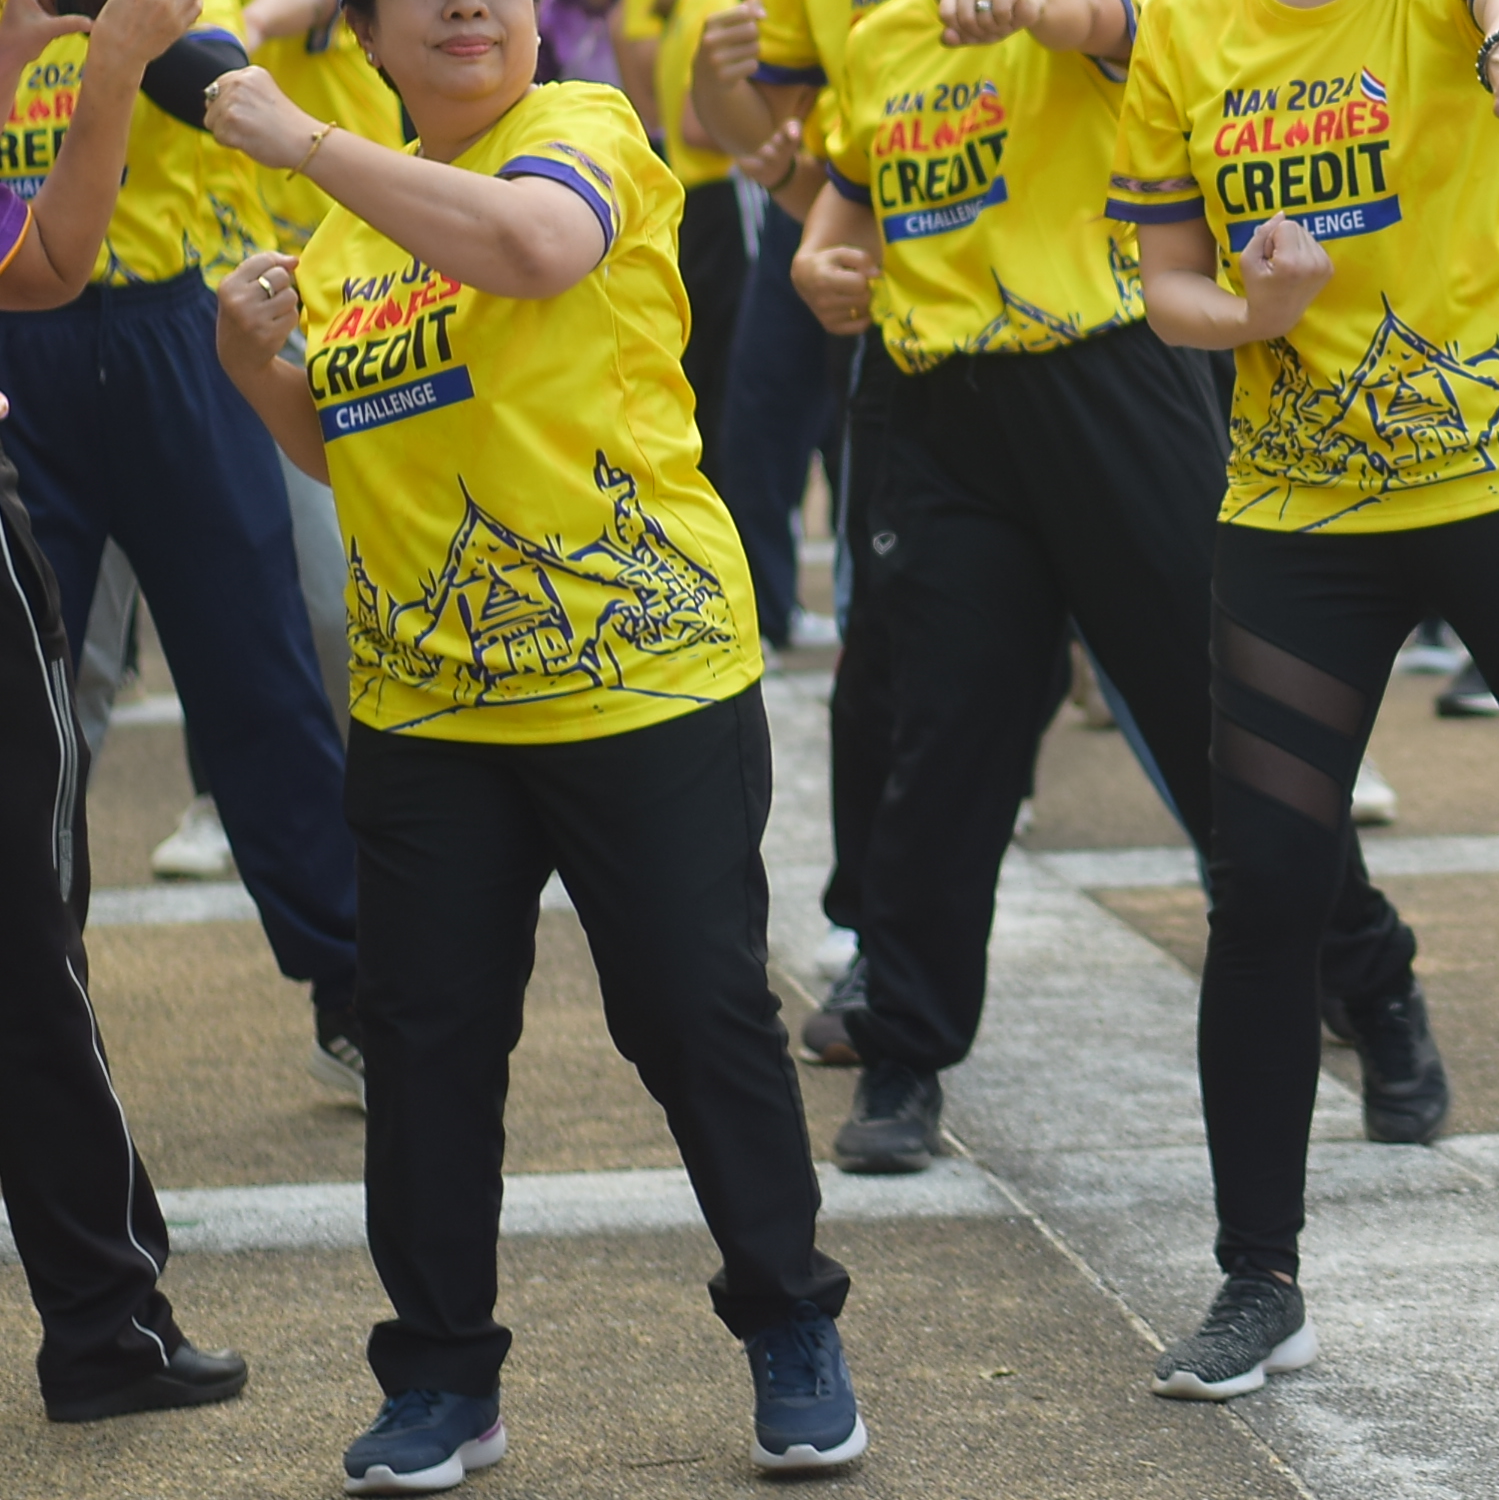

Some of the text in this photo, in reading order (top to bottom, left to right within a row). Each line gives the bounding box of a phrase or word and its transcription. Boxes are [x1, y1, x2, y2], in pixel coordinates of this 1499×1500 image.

[1222, 72, 1357, 118] NAN 2024
[878, 129, 1009, 209] CREDIT
[1216, 140, 1390, 215] CREDIT
[905, 200, 984, 234] CHALLEN
[343, 271, 396, 306] NAN
[307, 304, 457, 400] CREDIT
[336, 381, 437, 430] CHALLENGE
